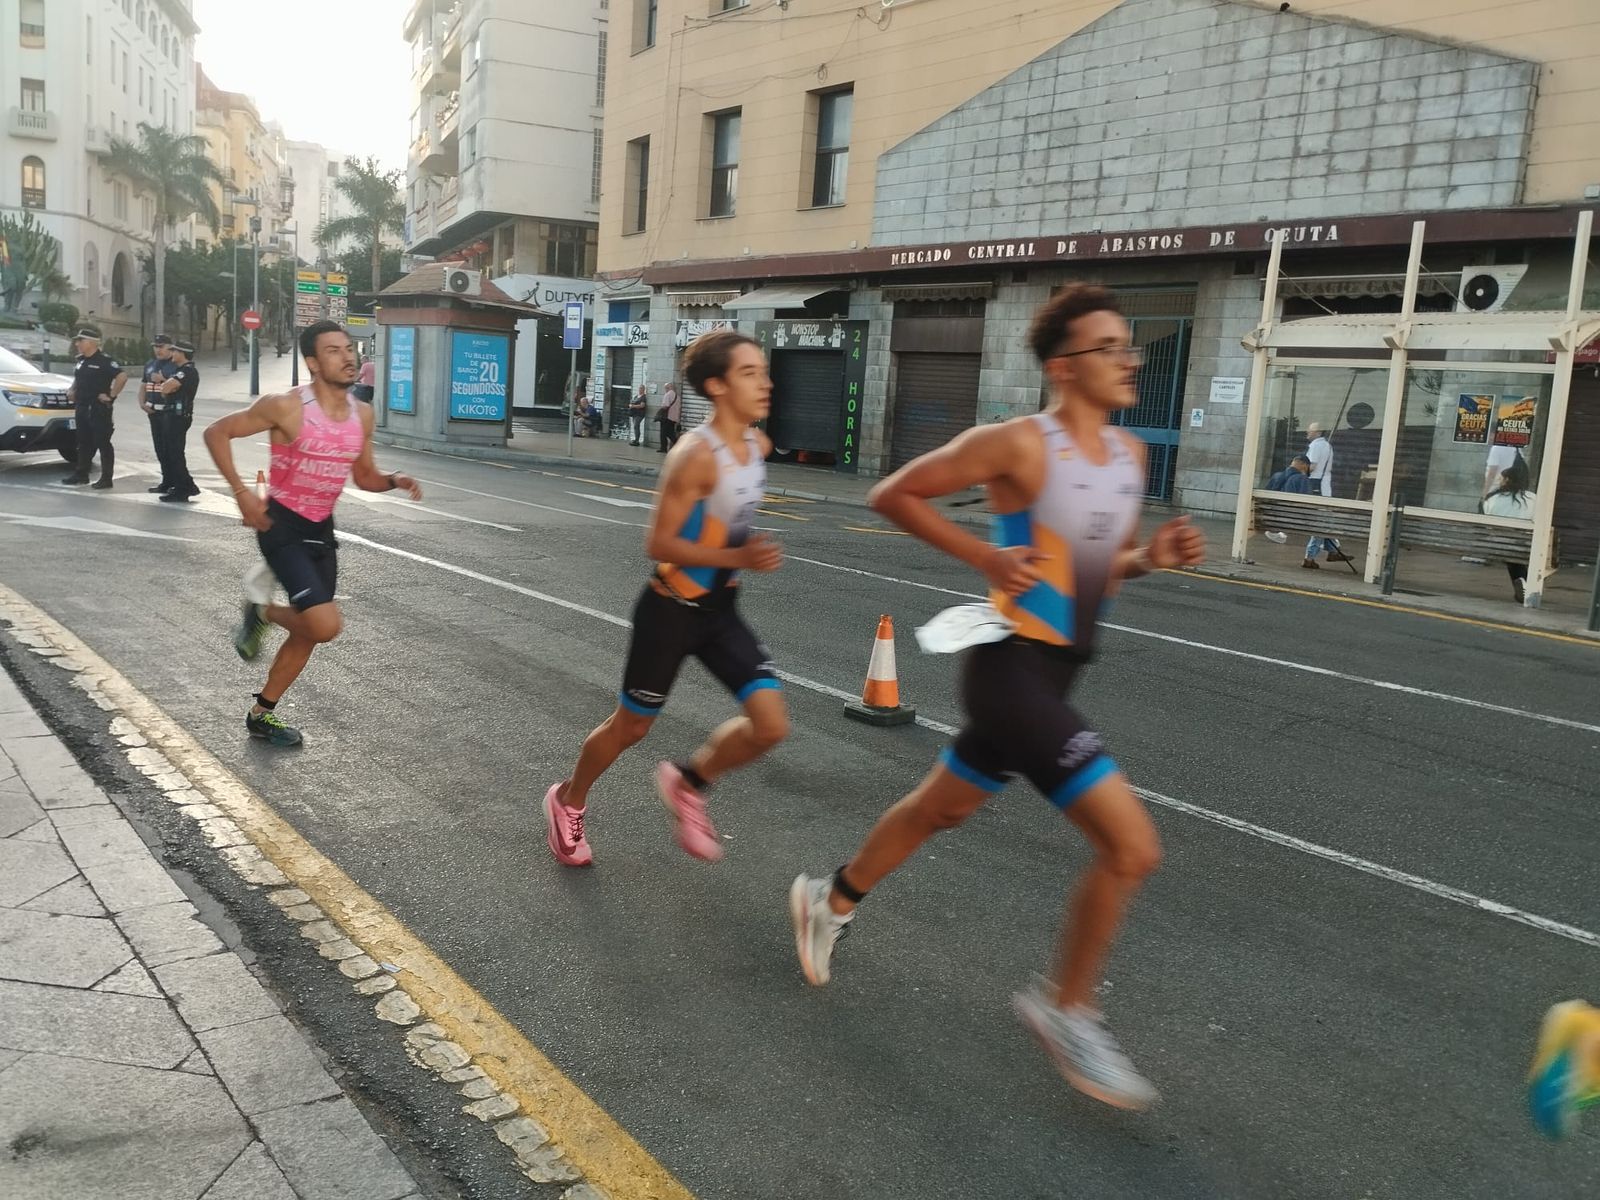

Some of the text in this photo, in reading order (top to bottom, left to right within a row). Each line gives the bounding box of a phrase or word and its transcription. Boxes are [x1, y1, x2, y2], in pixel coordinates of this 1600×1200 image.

[891, 248, 951, 265] MERCADO
[968, 243, 1036, 259] CENTRAL
[1056, 240, 1077, 254] DE
[1099, 233, 1184, 252] ABASTOS
[1209, 230, 1236, 247] DE
[791, 323, 820, 336] NONSTOP
[798, 334, 827, 347] MACHINE
[464, 351, 497, 361] TU BILLETE
[480, 361, 499, 383] 20
[844, 382, 858, 464] HORAS
[1460, 420, 1487, 429] CEUTA
